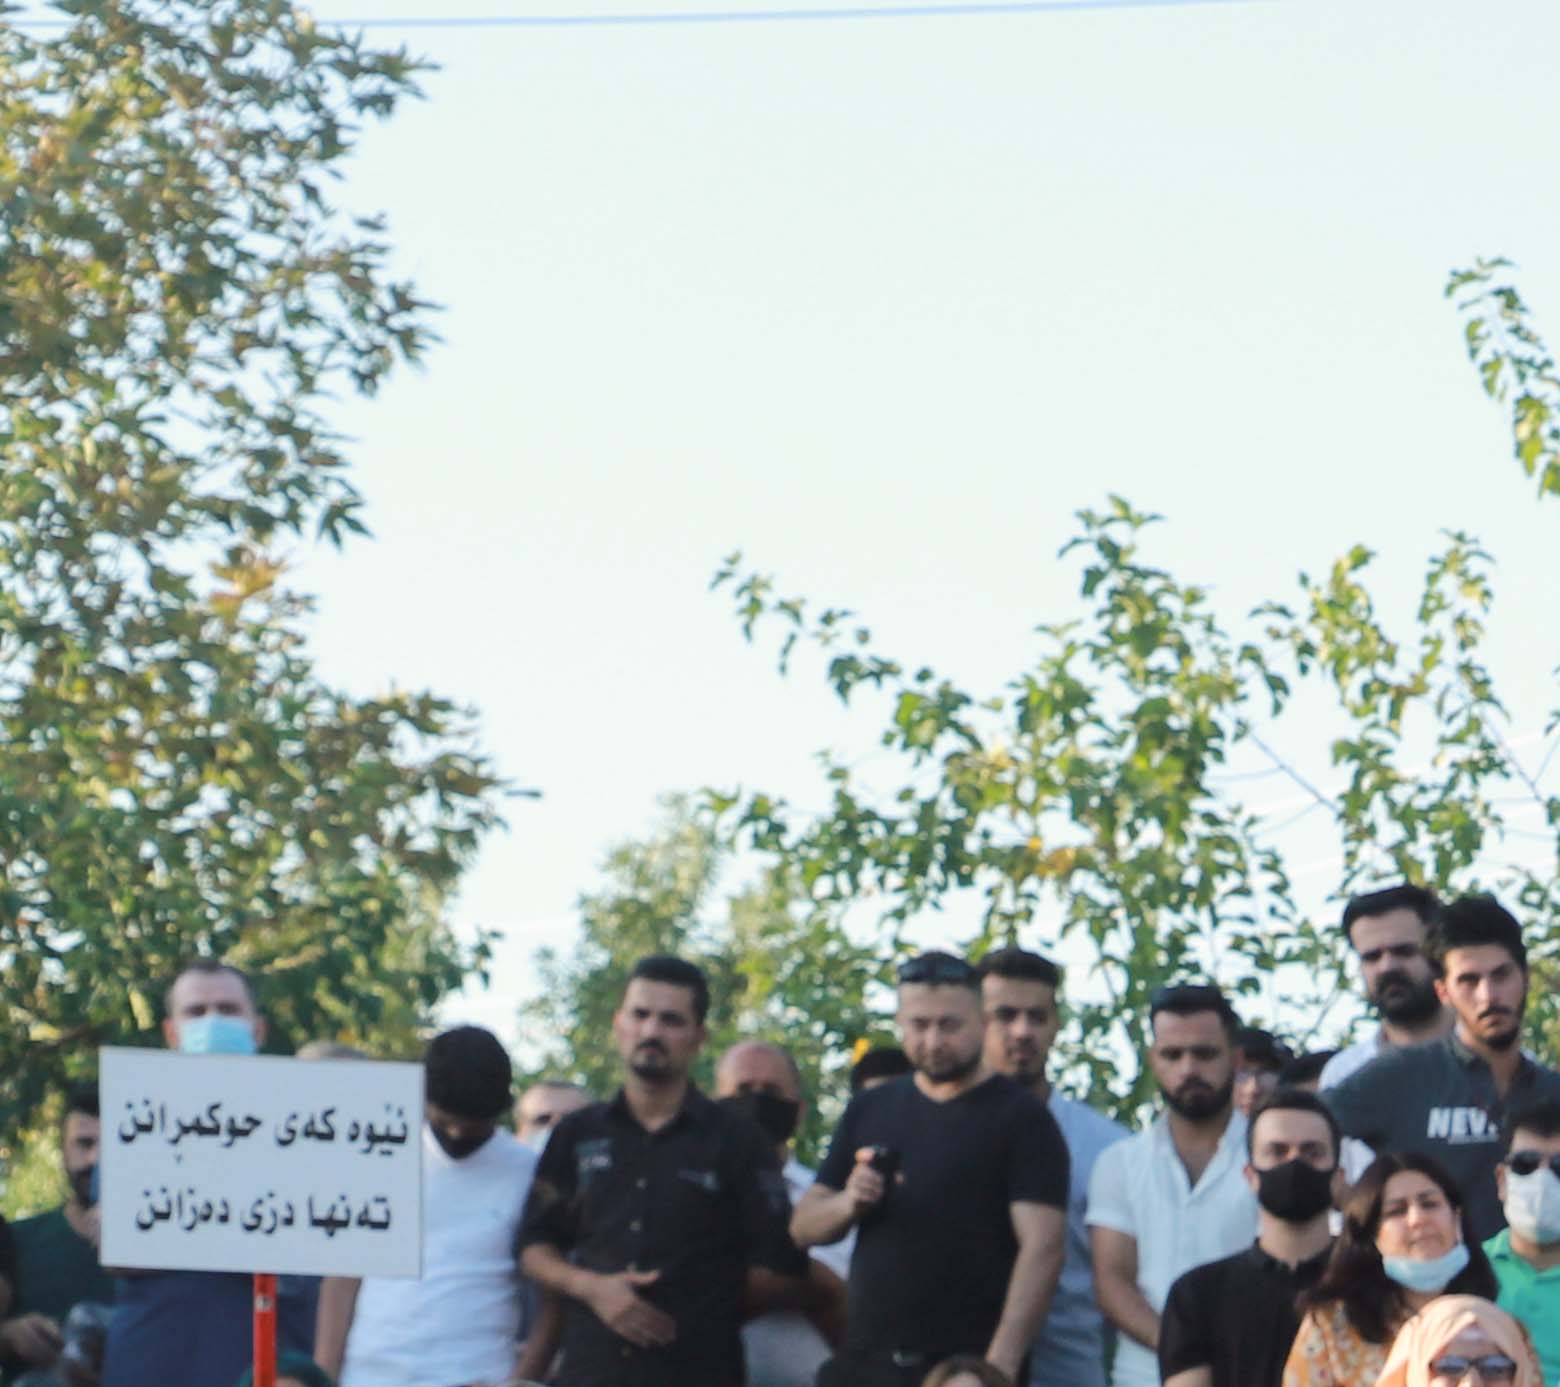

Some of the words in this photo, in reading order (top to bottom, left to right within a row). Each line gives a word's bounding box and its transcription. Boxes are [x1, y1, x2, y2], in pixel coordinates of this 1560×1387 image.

[275, 1107, 336, 1148] کەی
[135, 1187, 230, 1232] دەزانن
[241, 1191, 295, 1236] دزی
[308, 1195, 391, 1238] تەنها
